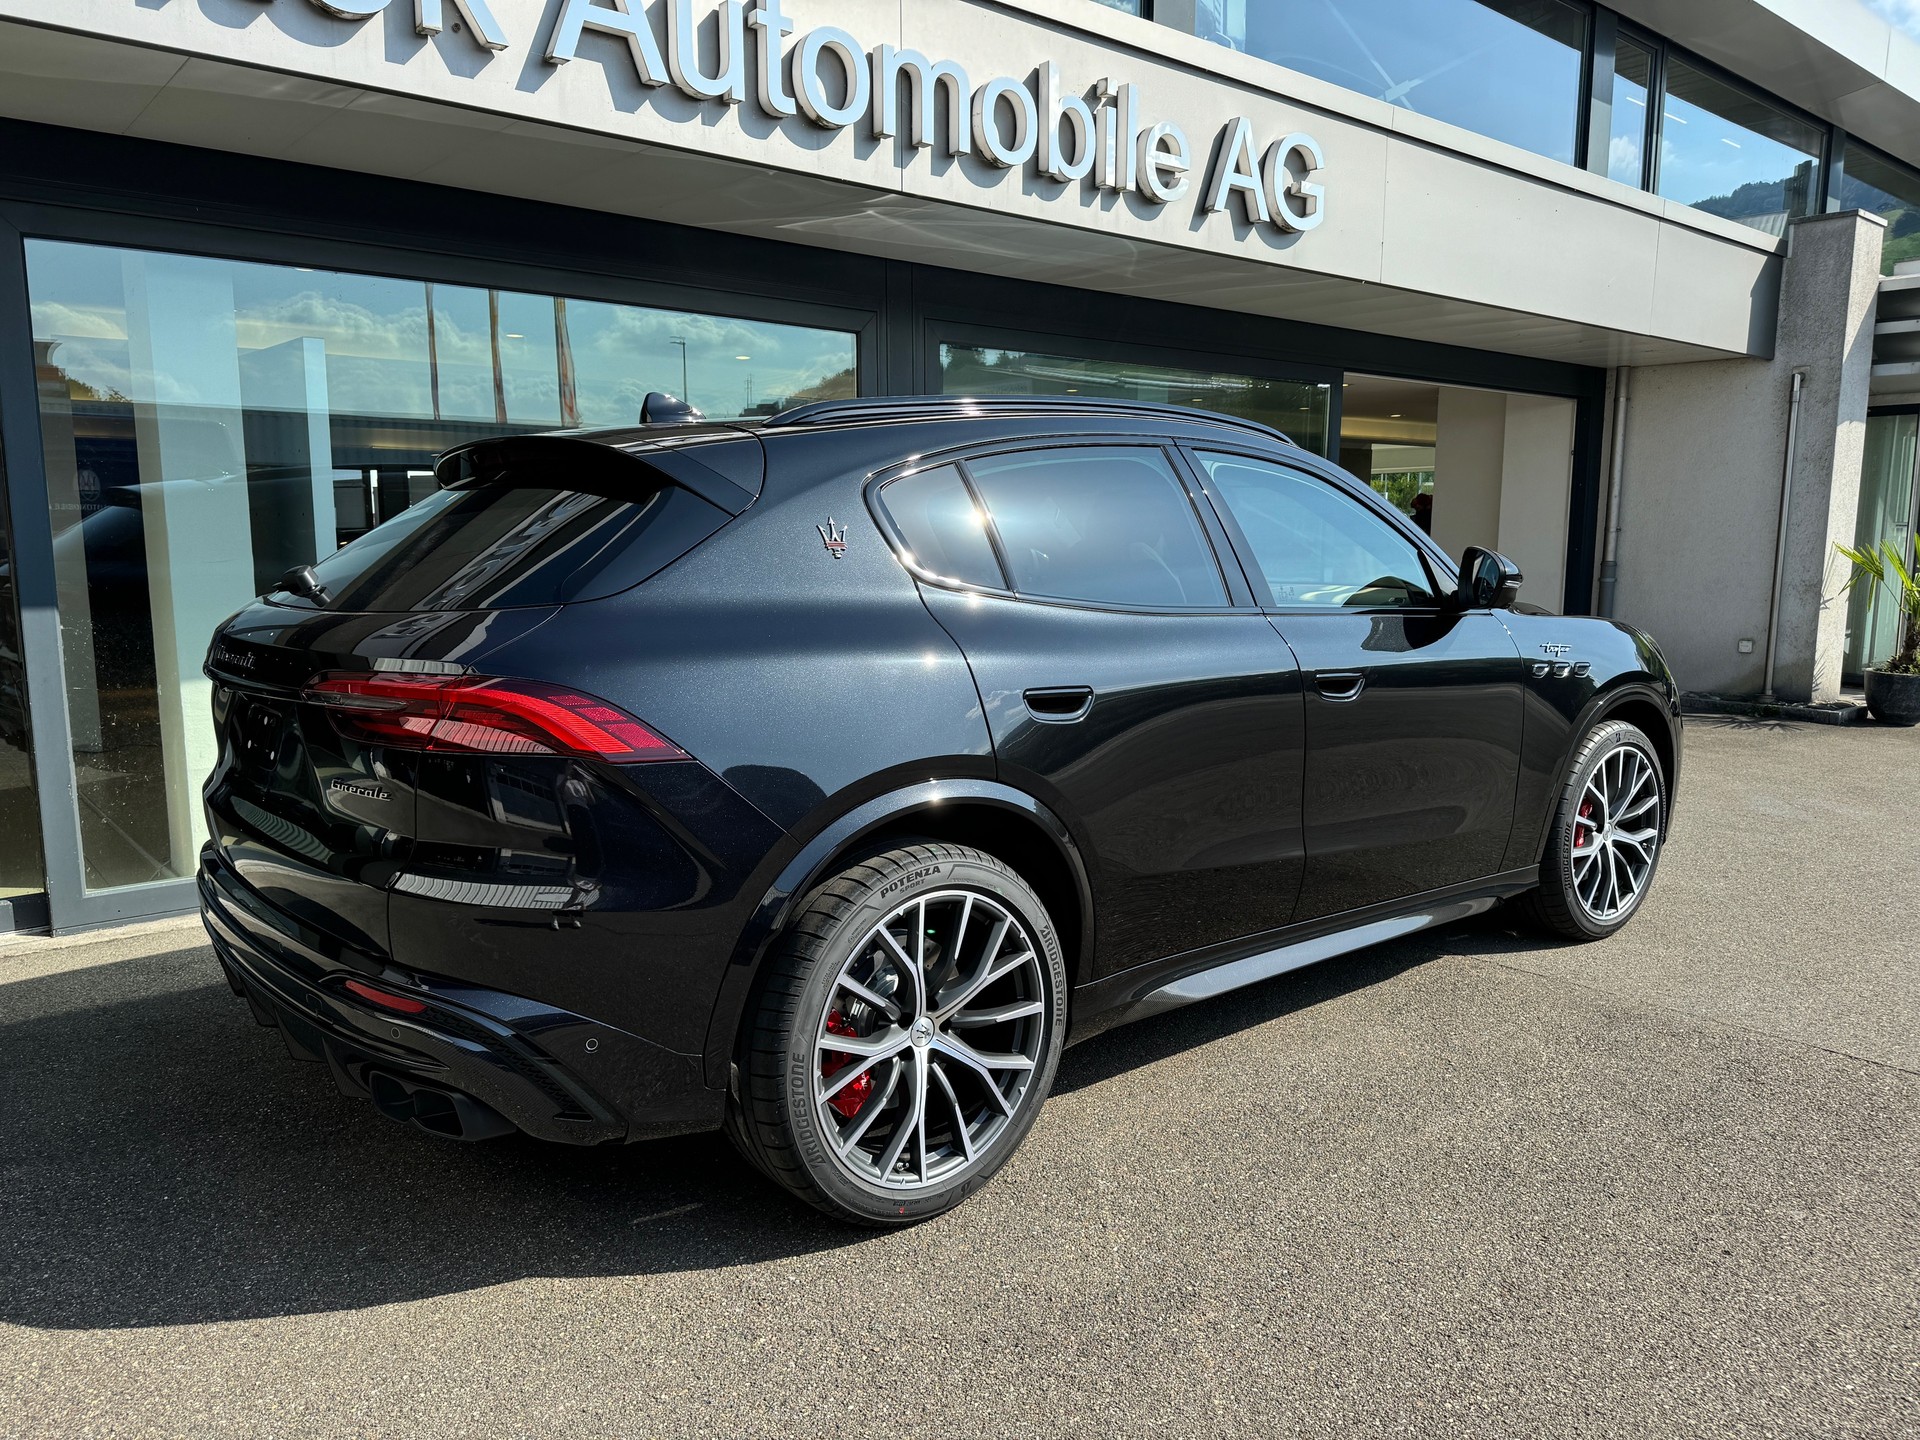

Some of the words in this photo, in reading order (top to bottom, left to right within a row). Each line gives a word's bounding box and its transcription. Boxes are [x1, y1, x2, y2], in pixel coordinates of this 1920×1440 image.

[545, 0, 1190, 203] Automobile
[1204, 116, 1325, 233] AG
[880, 865, 941, 899] POTENZA
[899, 879, 926, 895] SPORT
[1040, 924, 1064, 1027] BRIDGESTONE
[790, 1052, 827, 1171] BRIDGESTONE
